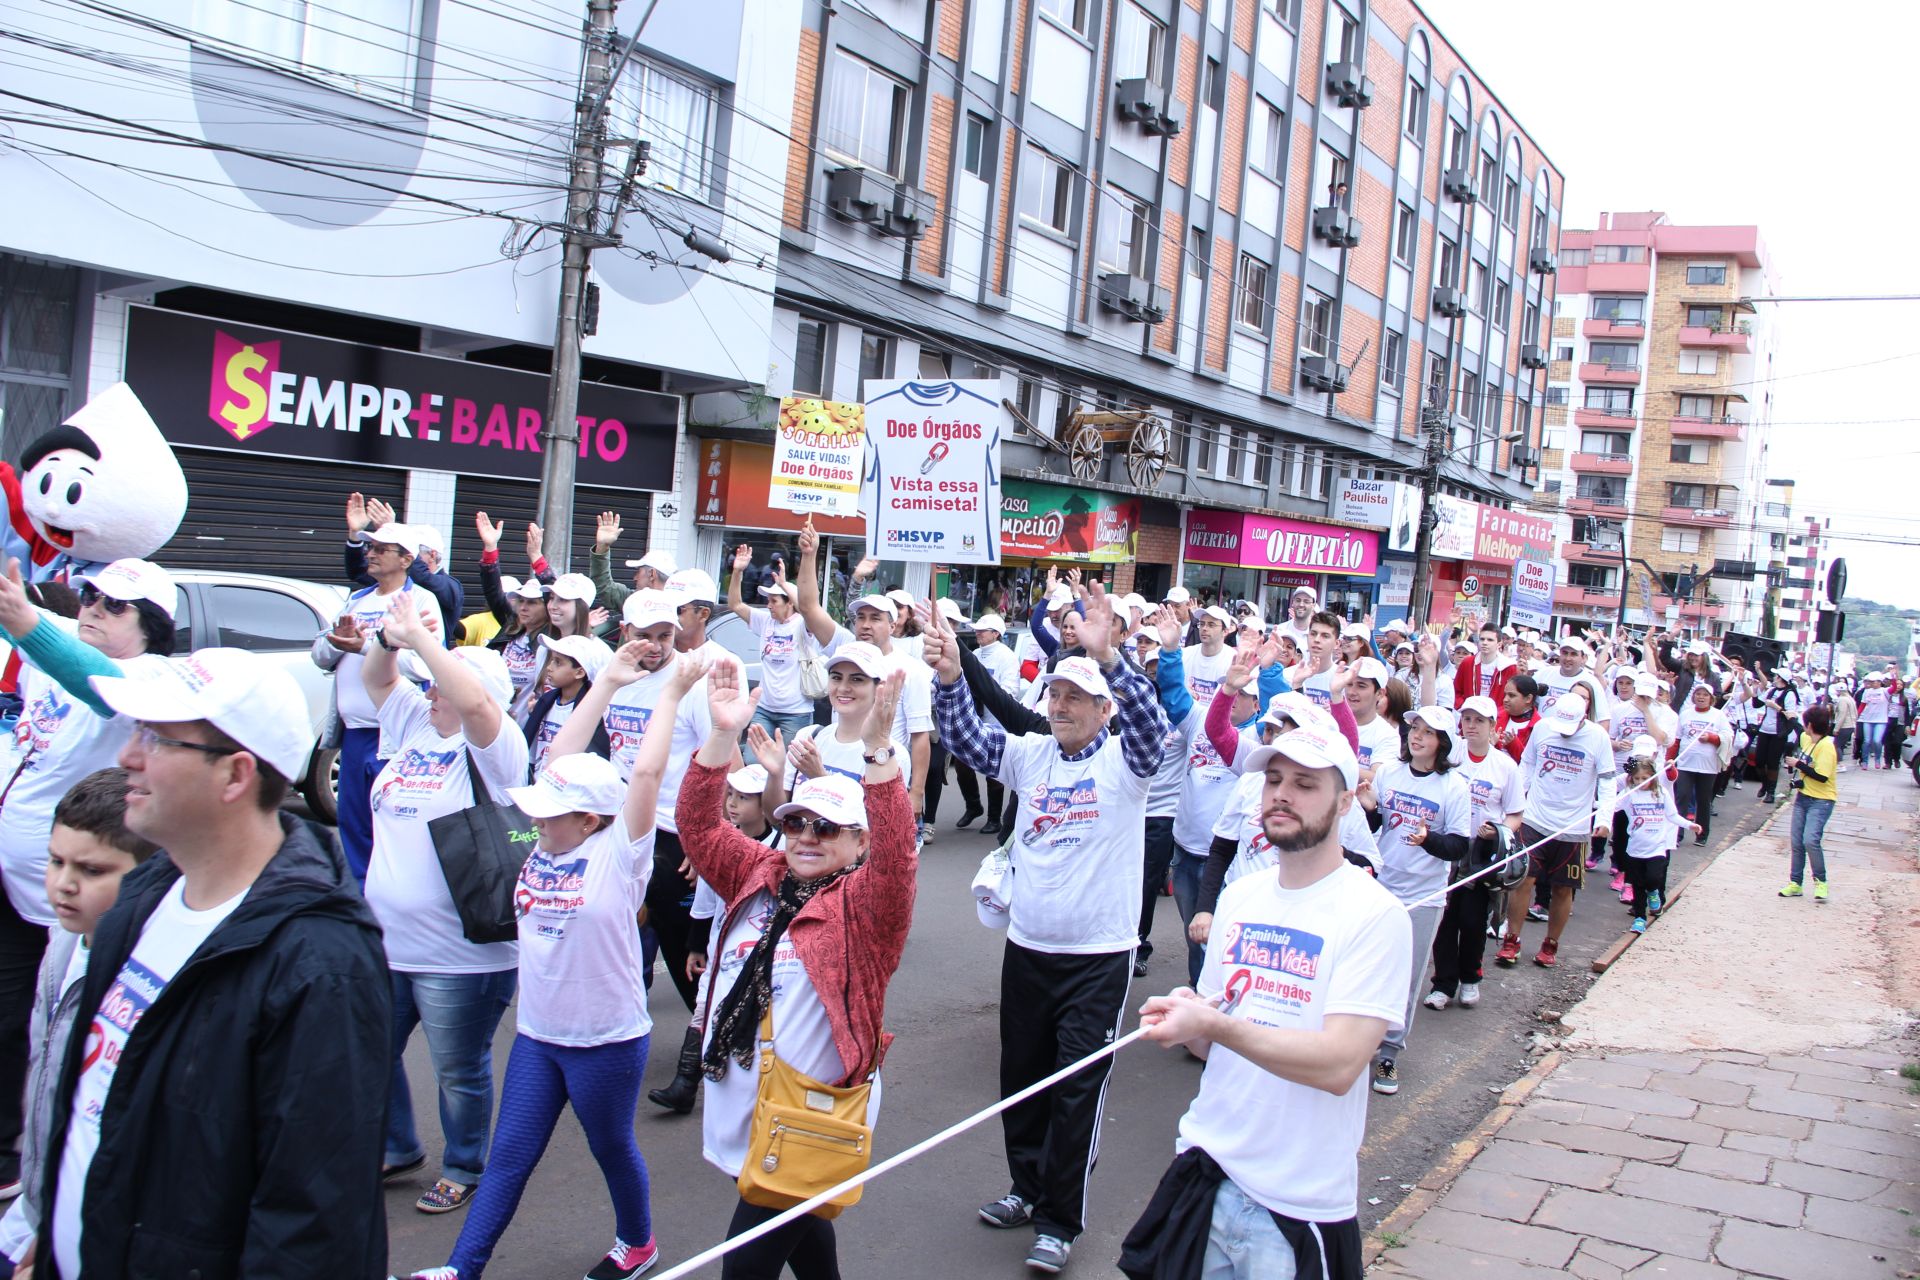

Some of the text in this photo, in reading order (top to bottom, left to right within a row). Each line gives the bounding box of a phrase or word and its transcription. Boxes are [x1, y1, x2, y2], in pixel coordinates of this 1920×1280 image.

[451, 398, 628, 462] BARTO
[887, 415, 982, 440] Doe Órgãos
[783, 425, 859, 449] SORRIA!
[788, 449, 850, 465] SALVE VIDAS!
[781, 461, 853, 480] Doe Órgãos
[890, 476, 978, 493] Vista essa
[1350, 479, 1384, 492] Bazar
[793, 492, 822, 502] HSVP
[891, 496, 978, 511] camiseta!
[1343, 491, 1388, 504] Paulista
[699, 514, 724, 522] MODAS
[1481, 508, 1553, 543] Farmacias
[898, 530, 944, 543] HSVP
[1189, 530, 1238, 550] OFERTÃO
[1252, 528, 1268, 541] LOJA
[1266, 530, 1364, 570] OFERTÃO
[1478, 533, 1523, 560] Melhor
[1526, 563, 1543, 577] Doe
[1272, 575, 1311, 586] OFERTÃO
[1464, 579, 1478, 592] 50
[1519, 573, 1549, 591] Órgãos
[1516, 610, 1533, 619] HSVP
[611, 707, 646, 719] Caminhada
[610, 715, 630, 731] Viva
[632, 722, 639, 732] a
[625, 735, 639, 746] Doe
[1548, 752, 1561, 761] Viva
[1029, 783, 1048, 811] 2
[1384, 790, 1394, 809] 2
[1067, 809, 1099, 820] Órgãos
[1394, 800, 1412, 813] Viva
[1416, 806, 1437, 821] Vida!
[1567, 864, 1579, 880] 10
[1222, 922, 1242, 965] 2
[1240, 940, 1270, 967] Viva
[1280, 945, 1319, 978] Vida!
[1255, 975, 1275, 991] Doe
